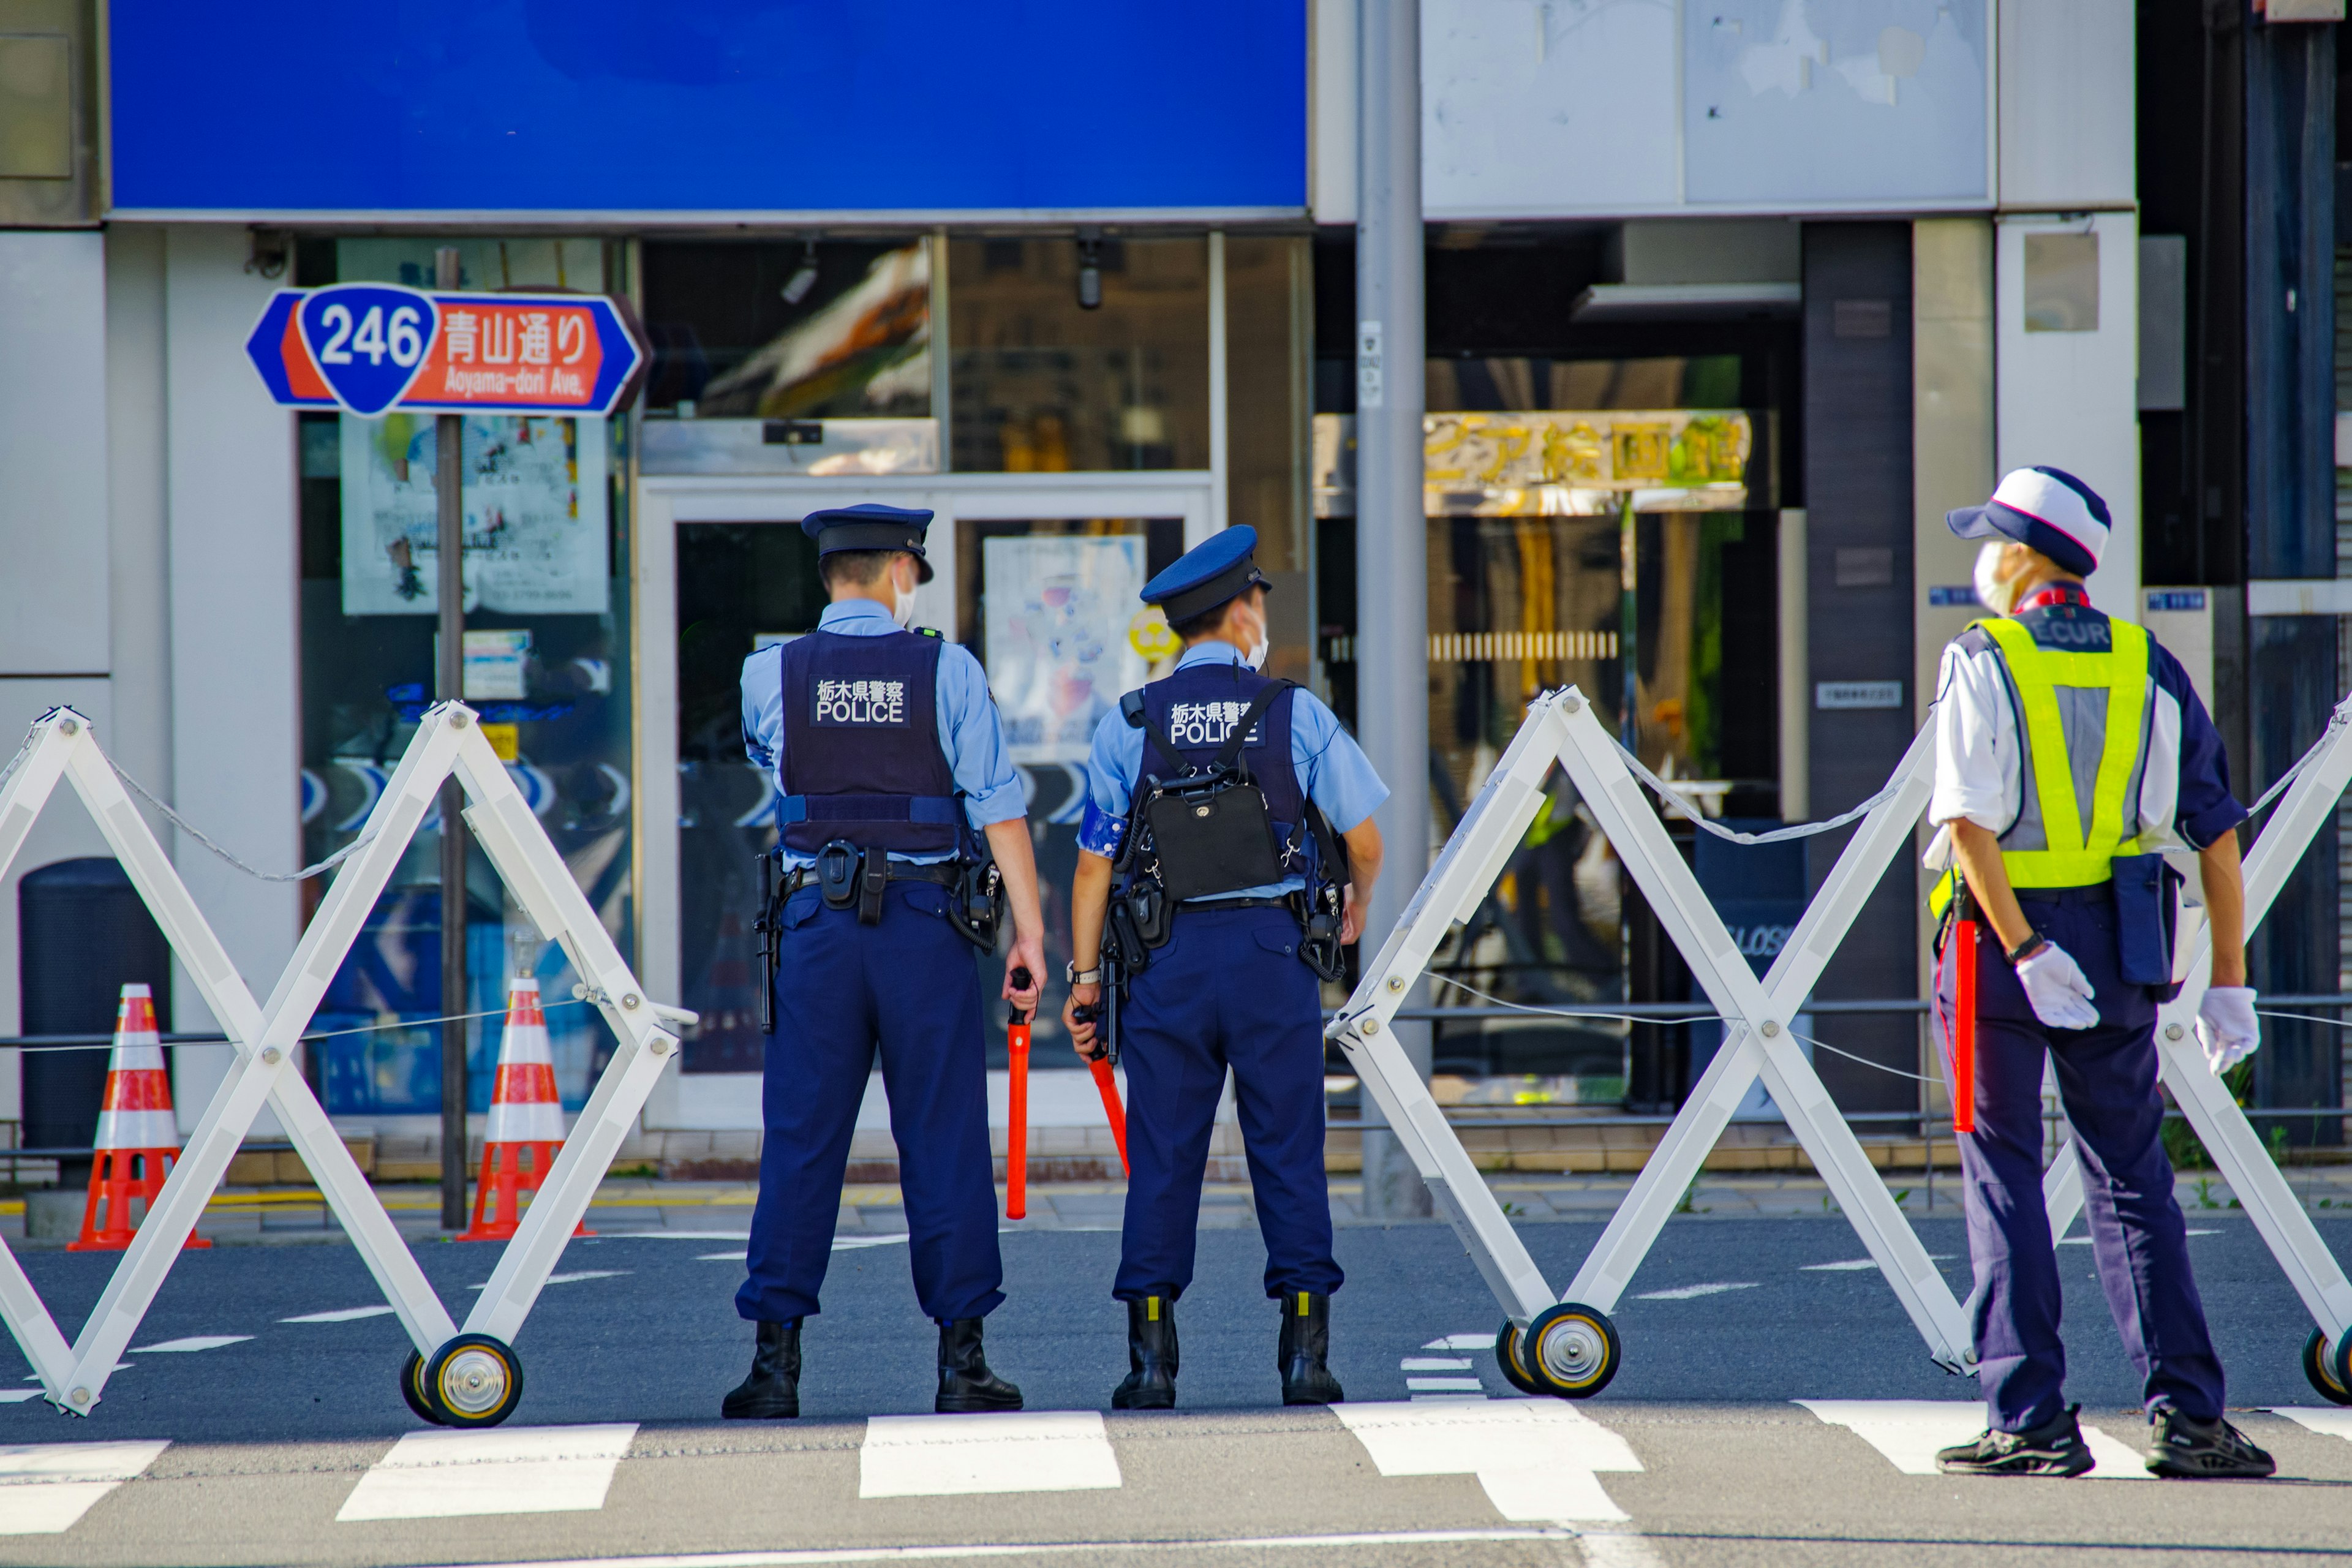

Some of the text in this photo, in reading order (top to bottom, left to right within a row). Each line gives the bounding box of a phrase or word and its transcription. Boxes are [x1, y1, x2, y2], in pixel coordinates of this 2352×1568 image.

[321, 304, 423, 368] 246
[444, 311, 586, 364] 青山通り
[444, 366, 586, 399] Aoyama-dori Ave.
[2030, 620, 2111, 644] ECUR
[816, 679, 904, 702] 栃木県警察
[816, 701, 904, 723] POLICE
[1726, 924, 1795, 957] LOS
